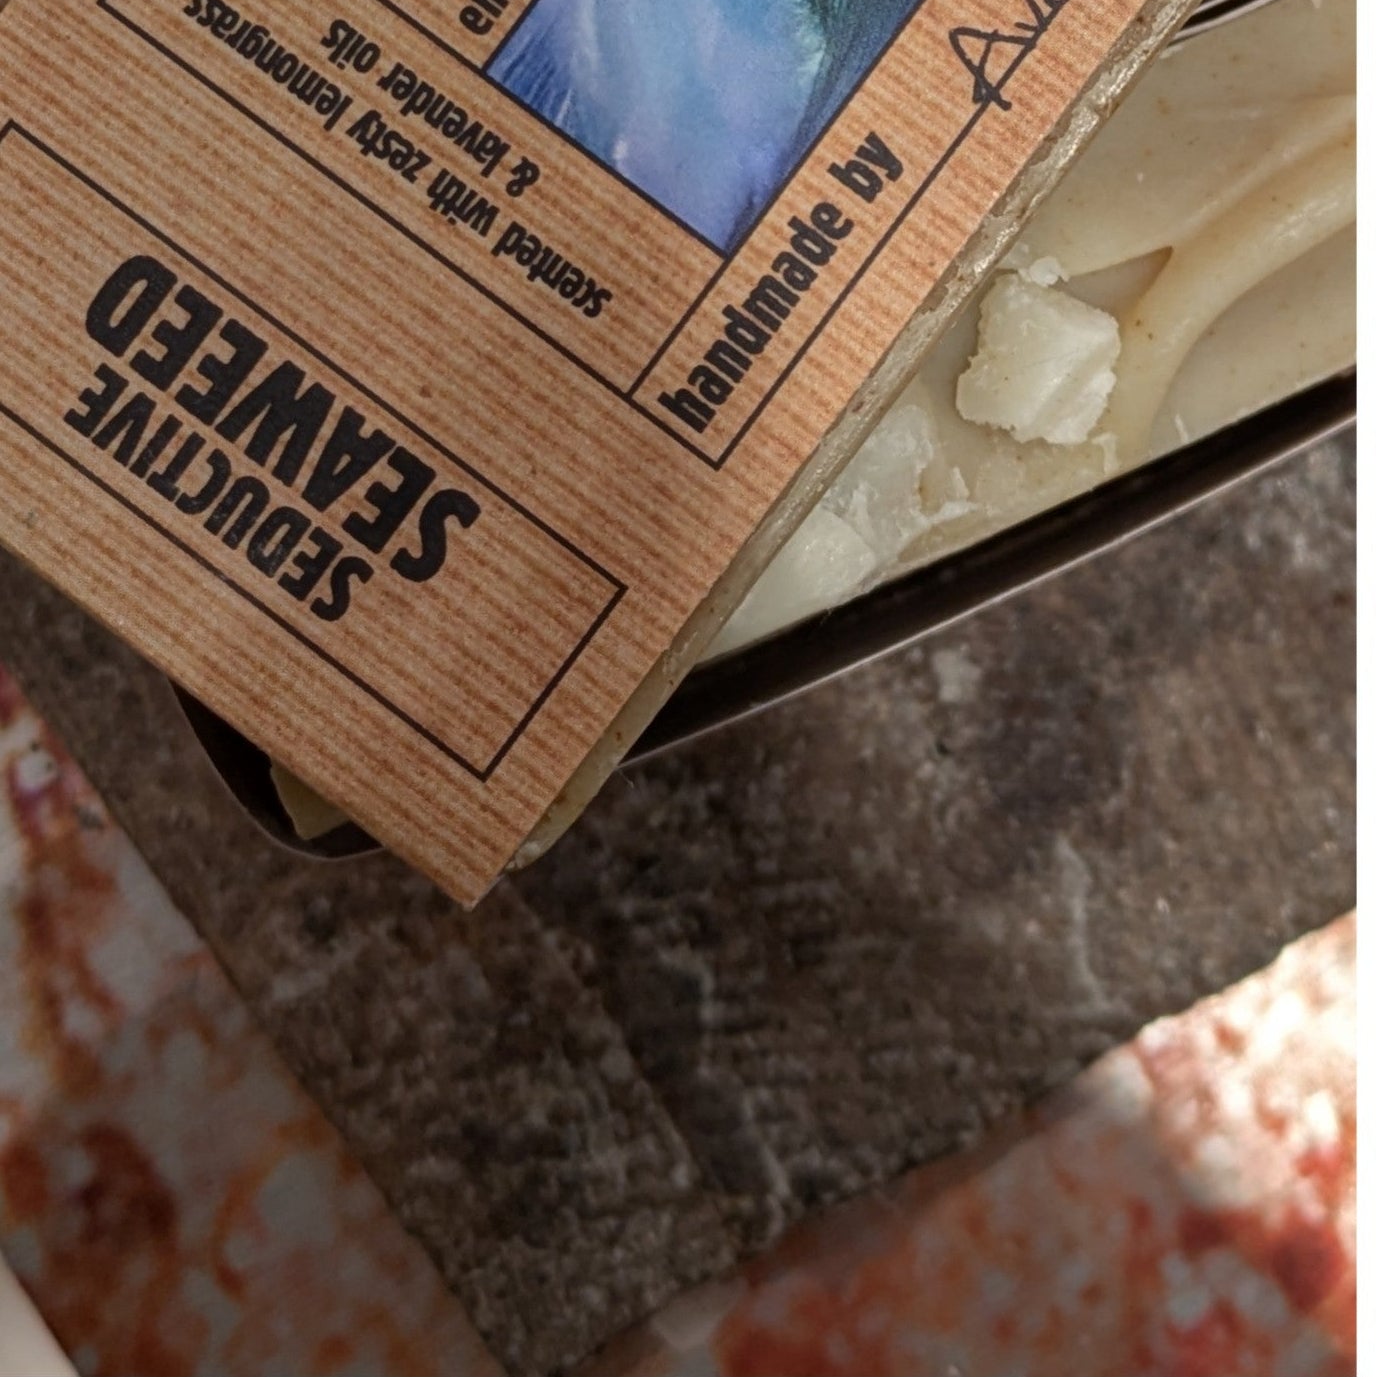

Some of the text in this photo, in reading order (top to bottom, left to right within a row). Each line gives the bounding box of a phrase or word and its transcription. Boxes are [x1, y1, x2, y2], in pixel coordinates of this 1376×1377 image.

[320, 18, 541, 198] & lavender oils
[346, 108, 434, 186] zesty
[425, 166, 501, 238] with
[496, 222, 614, 319] scented
[657, 198, 855, 435] handmade
[829, 130, 906, 205] by
[63, 362, 374, 622] SEDUCTIVE
[84, 254, 482, 583] SEAWEED
